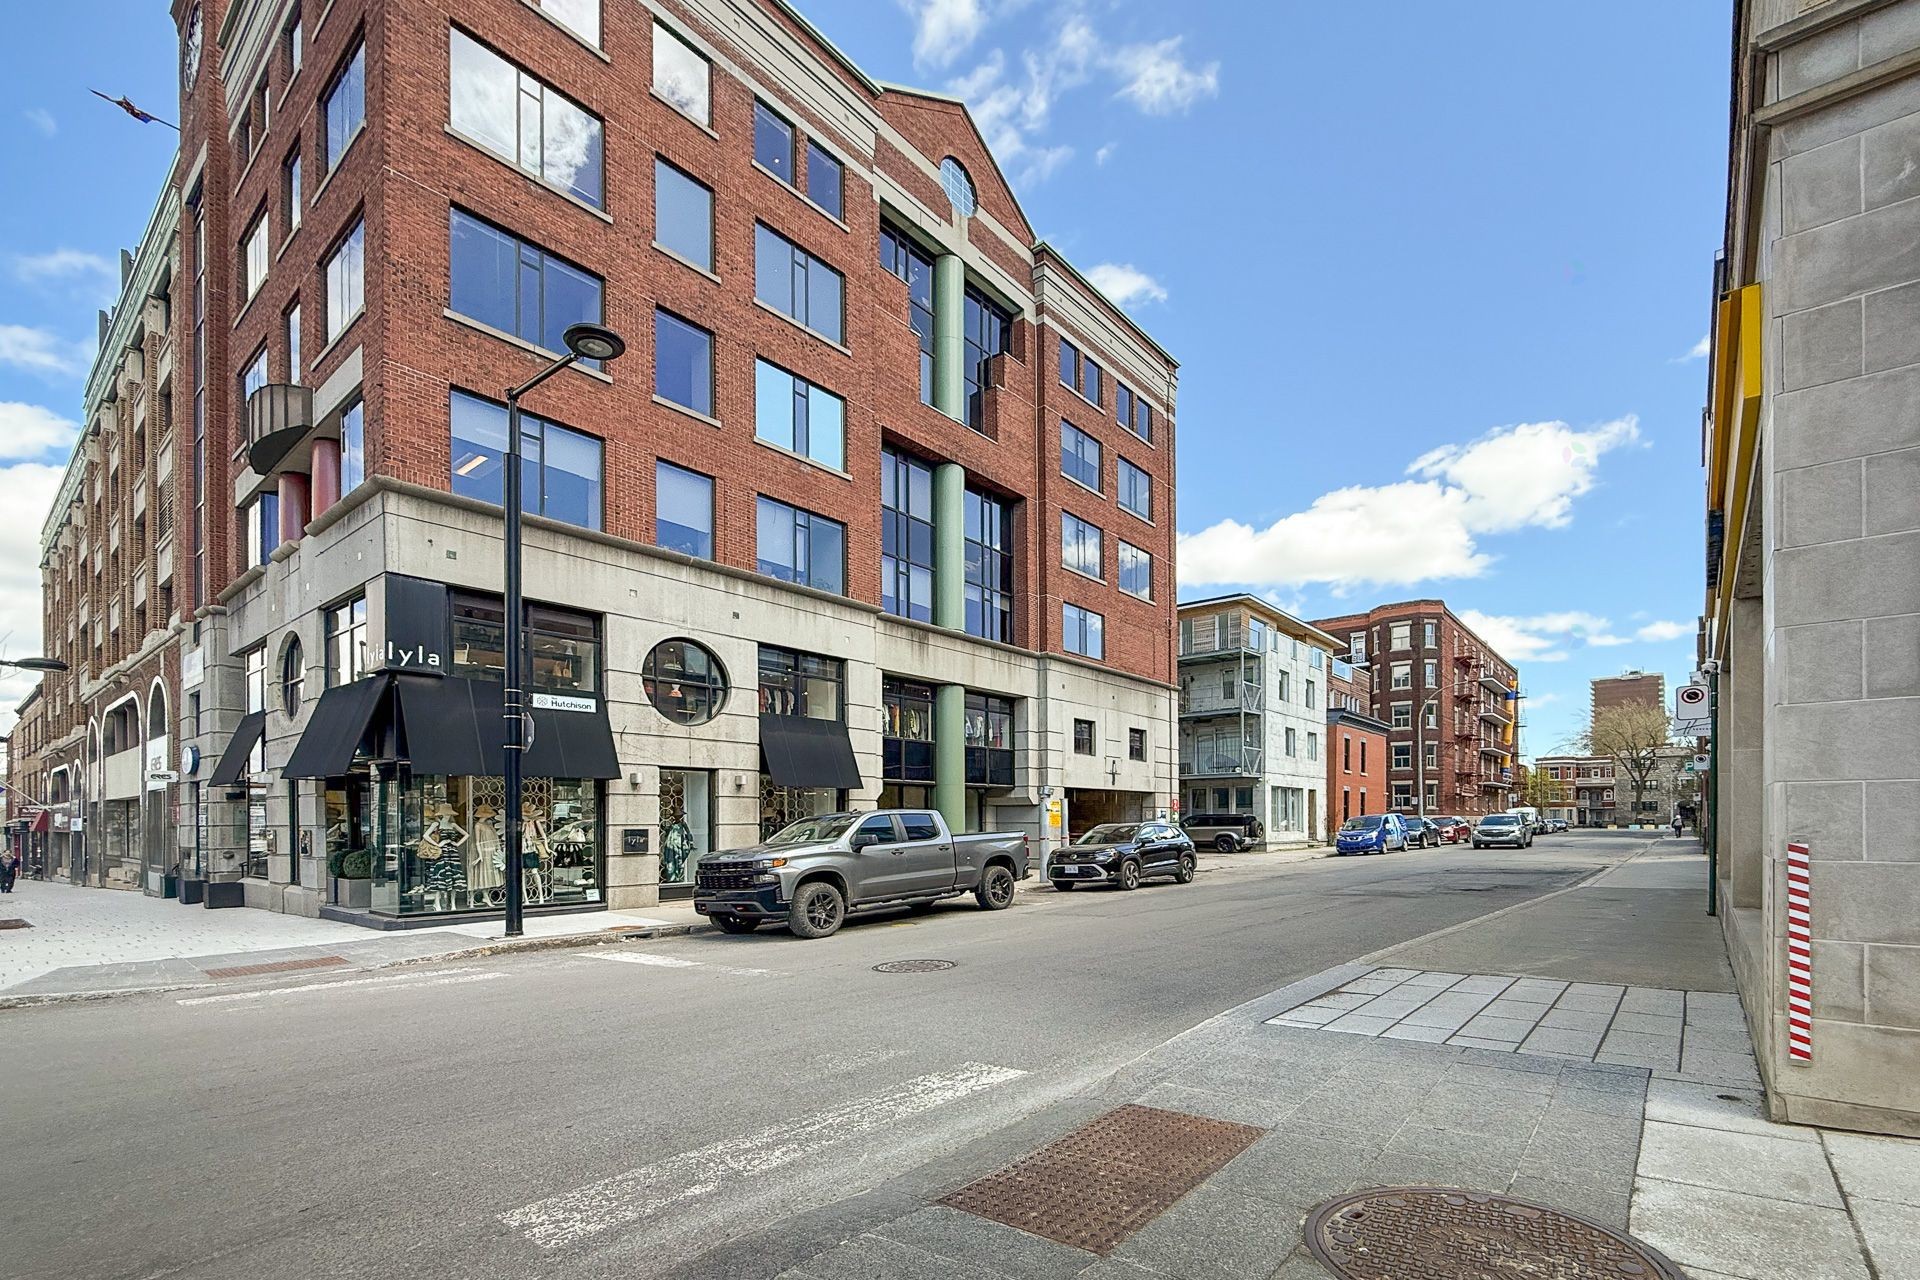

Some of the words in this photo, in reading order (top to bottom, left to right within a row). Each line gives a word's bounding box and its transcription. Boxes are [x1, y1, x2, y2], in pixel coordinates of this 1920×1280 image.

[366, 643, 384, 668] lyla
[388, 641, 440, 667] lyla
[551, 700, 592, 710] Hutchison
